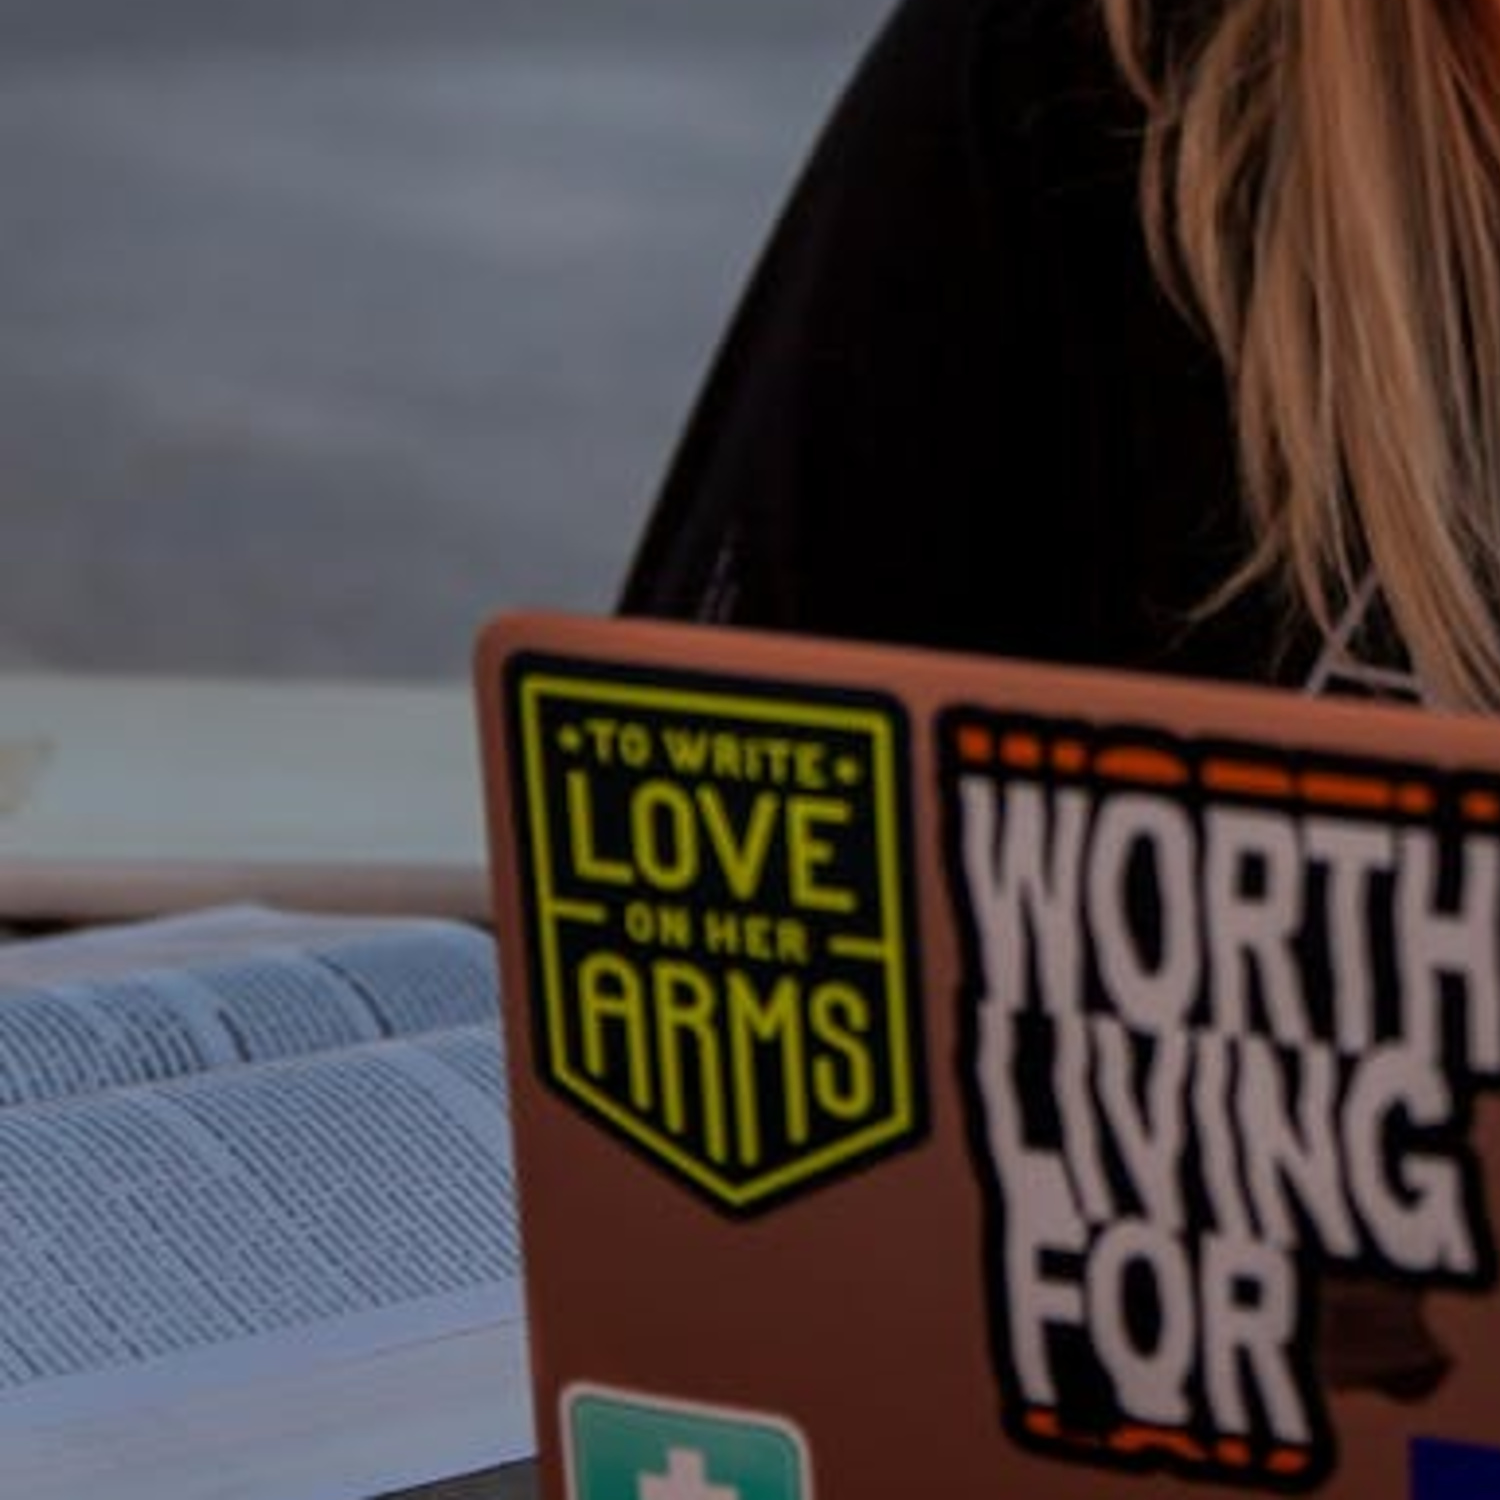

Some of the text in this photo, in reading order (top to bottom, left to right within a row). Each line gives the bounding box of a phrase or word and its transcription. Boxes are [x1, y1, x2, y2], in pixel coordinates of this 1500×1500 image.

[566, 770, 855, 912] LOVE
[584, 717, 826, 788] TO WRITE
[624, 901, 810, 965] ON HER
[577, 952, 876, 1168] ARMS
[977, 1000, 1478, 1274] LIVING
[1006, 1212, 1312, 1446] FOR
